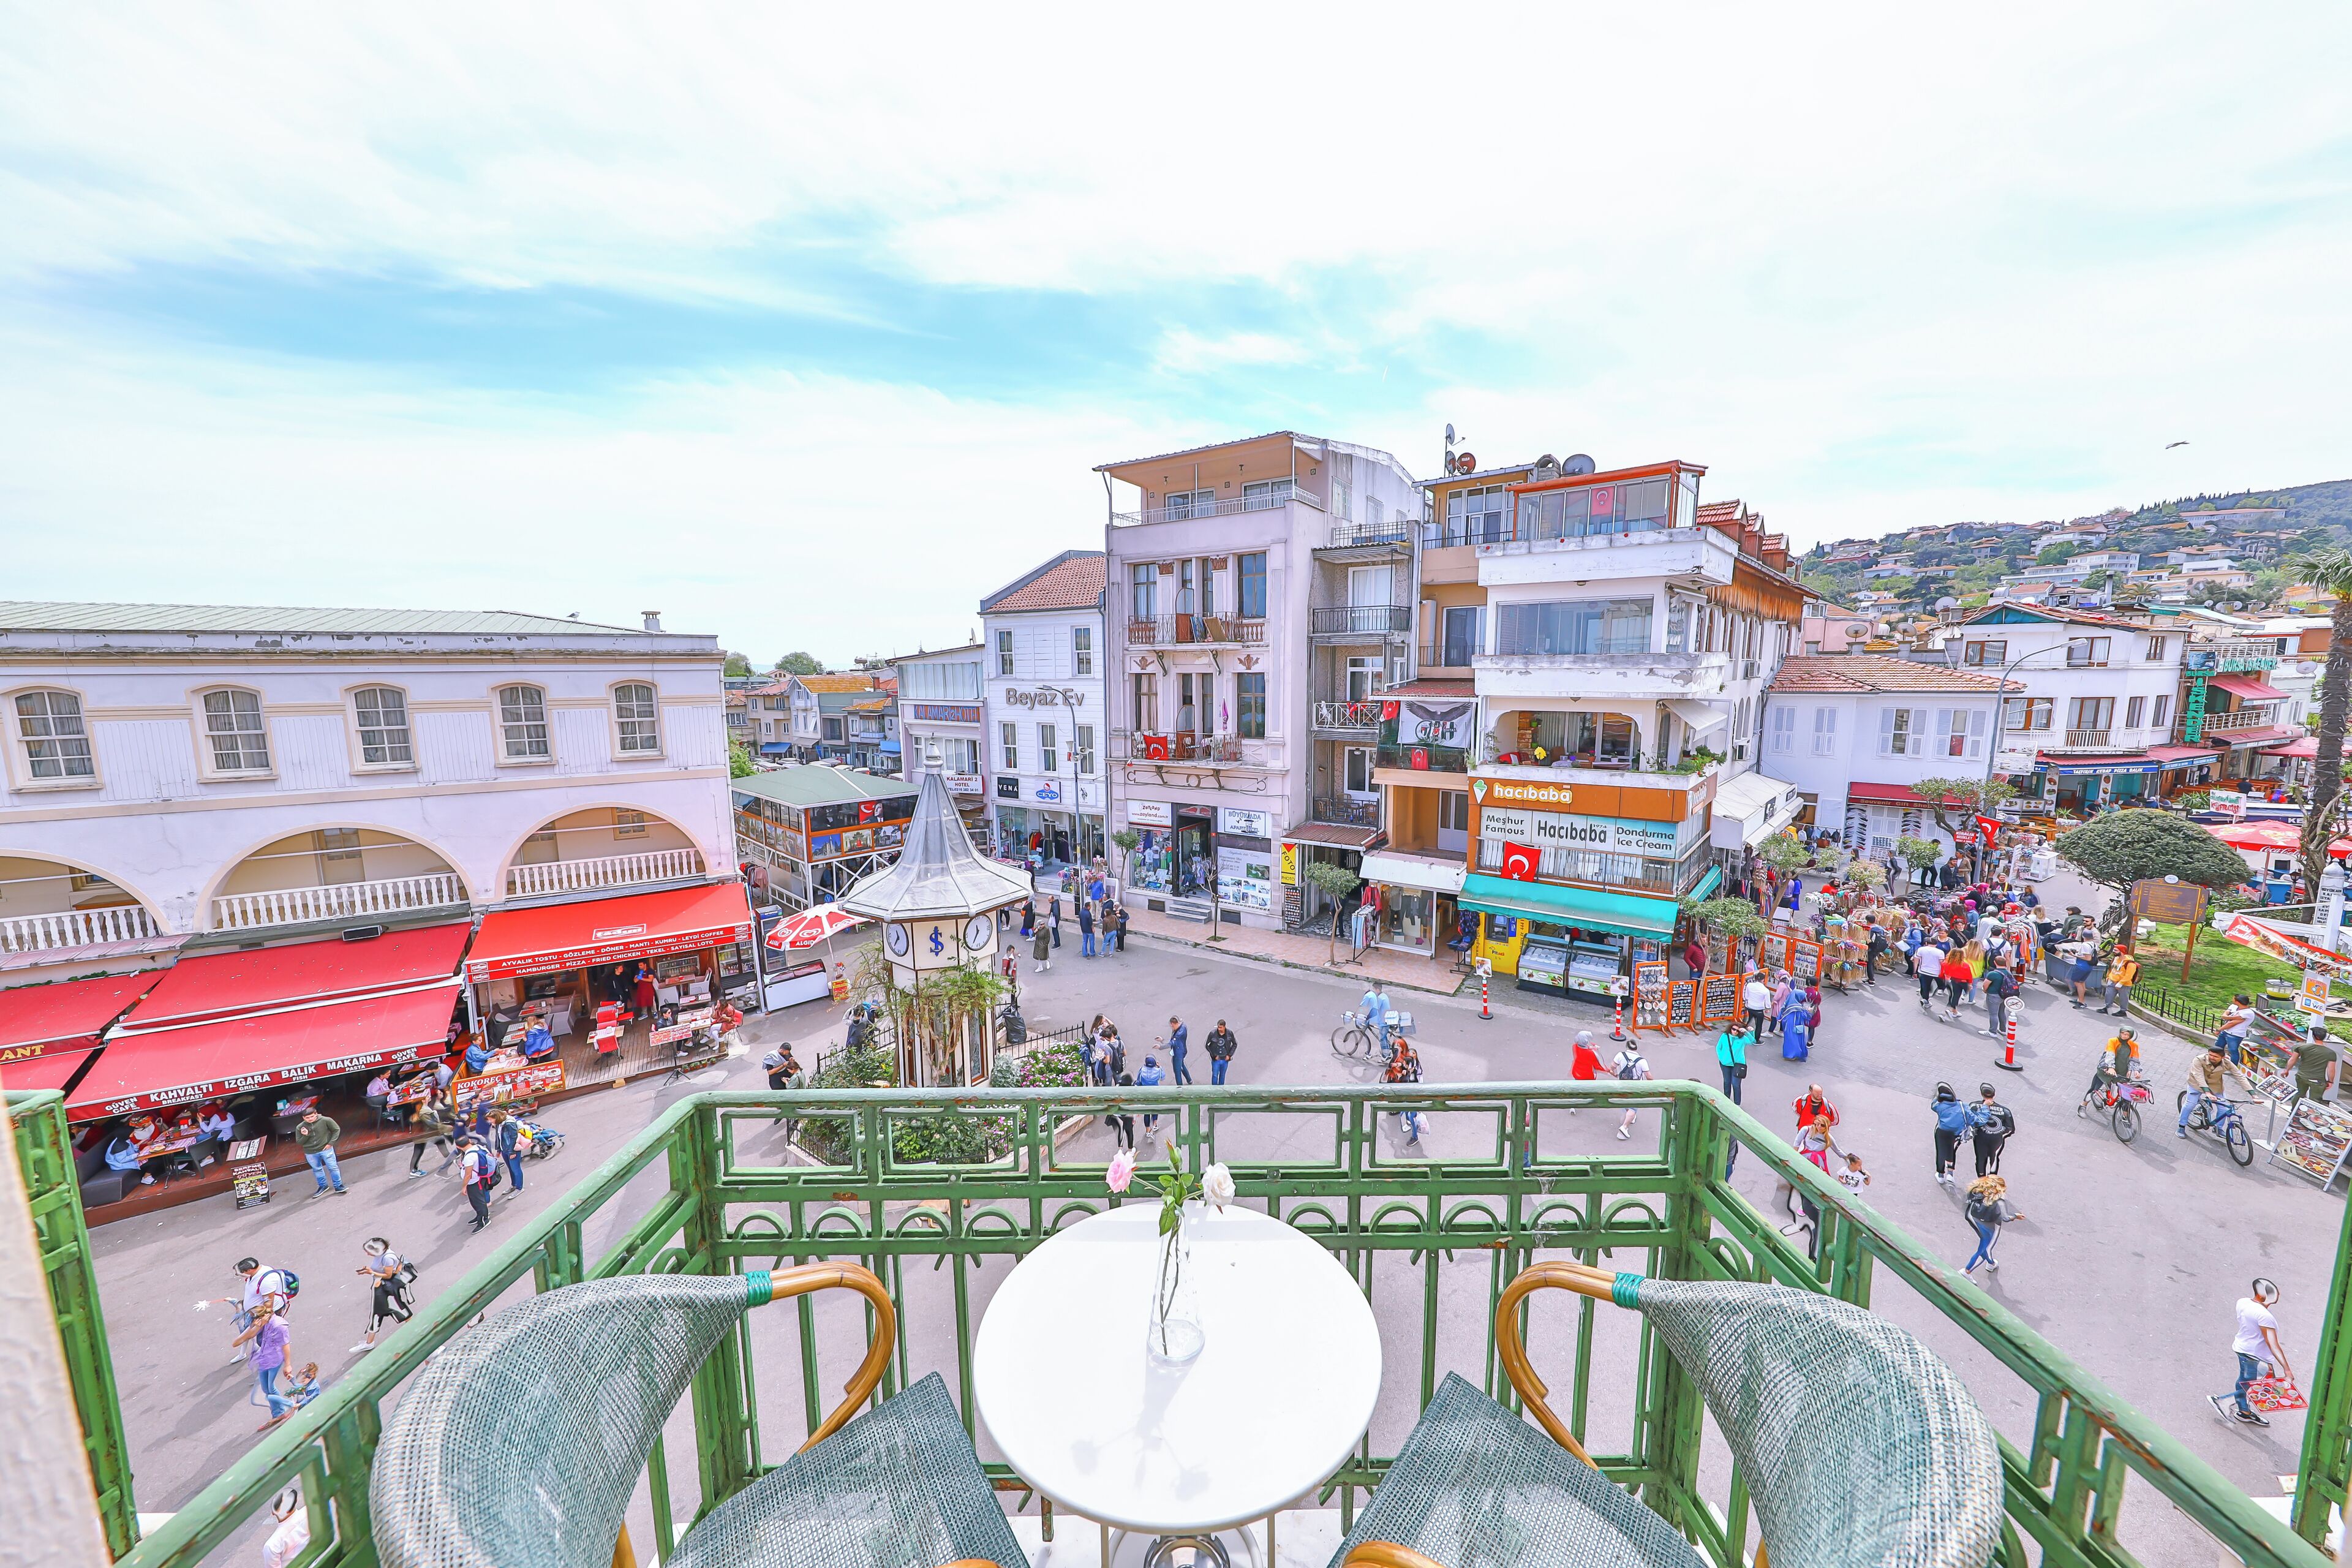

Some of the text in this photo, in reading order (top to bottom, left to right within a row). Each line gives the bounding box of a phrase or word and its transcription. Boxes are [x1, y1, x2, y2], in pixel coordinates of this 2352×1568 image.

[1006, 688, 1085, 710] Beyaz Ev
[1494, 784, 1571, 802] hacıbaba
[1487, 815, 1525, 826] Meşhur
[1485, 824, 1525, 835] Famous
[1537, 820, 1607, 843] Hacıbaba
[1616, 827, 1675, 840] Dondurma
[1618, 837, 1672, 851] Ice Cream
[1281, 851, 1295, 871] FOTO
[501, 958, 533, 967] AYVALIK
[564, 949, 595, 959] GÖZLEME
[516, 964, 560, 974] HAMBURGER
[612, 951, 641, 960] CHICKEN
[0, 1045, 45, 1060] ANT
[391, 1047, 417, 1060] GÜVEN
[397, 1052, 417, 1062] CAFE
[150, 1054, 382, 1102] KAHVALTI IZGARA BALIK MAKARNA
[457, 1075, 502, 1090] KOKOREÇ
[105, 1097, 138, 1111] GÜVEN
[162, 1093, 204, 1105] BREAKFAST
[113, 1103, 137, 1114] CAFE
[233, 1166, 265, 1175] KAHVALTI
